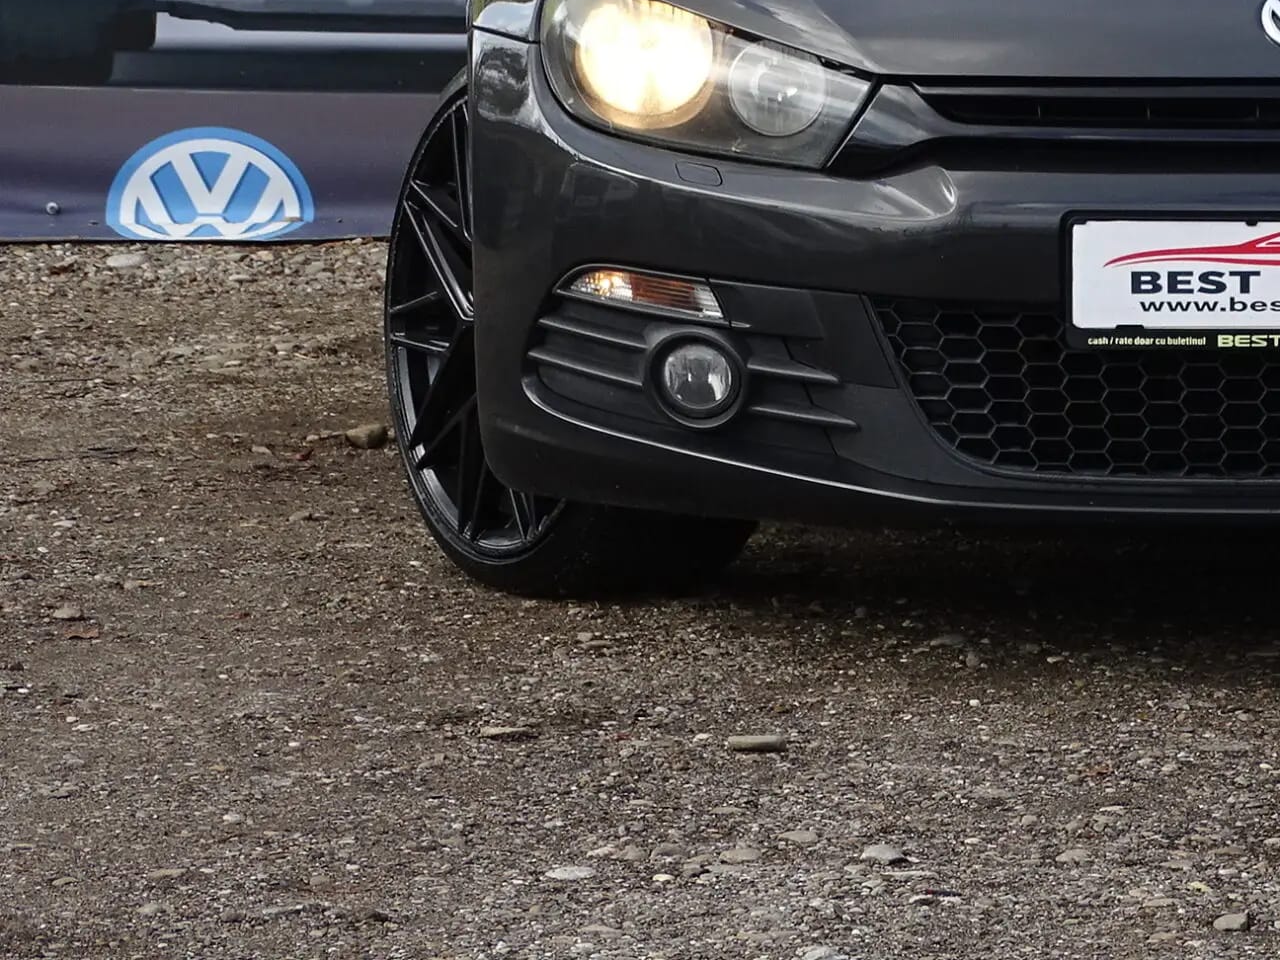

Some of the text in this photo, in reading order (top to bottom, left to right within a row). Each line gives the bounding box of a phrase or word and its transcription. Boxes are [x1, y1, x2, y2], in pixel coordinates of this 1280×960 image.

[1130, 270, 1261, 294] BEST
[1087, 336, 1108, 345] cash
[1115, 336, 1133, 345] rate
[1134, 336, 1154, 345] doar
[1167, 336, 1206, 346] buletinul
